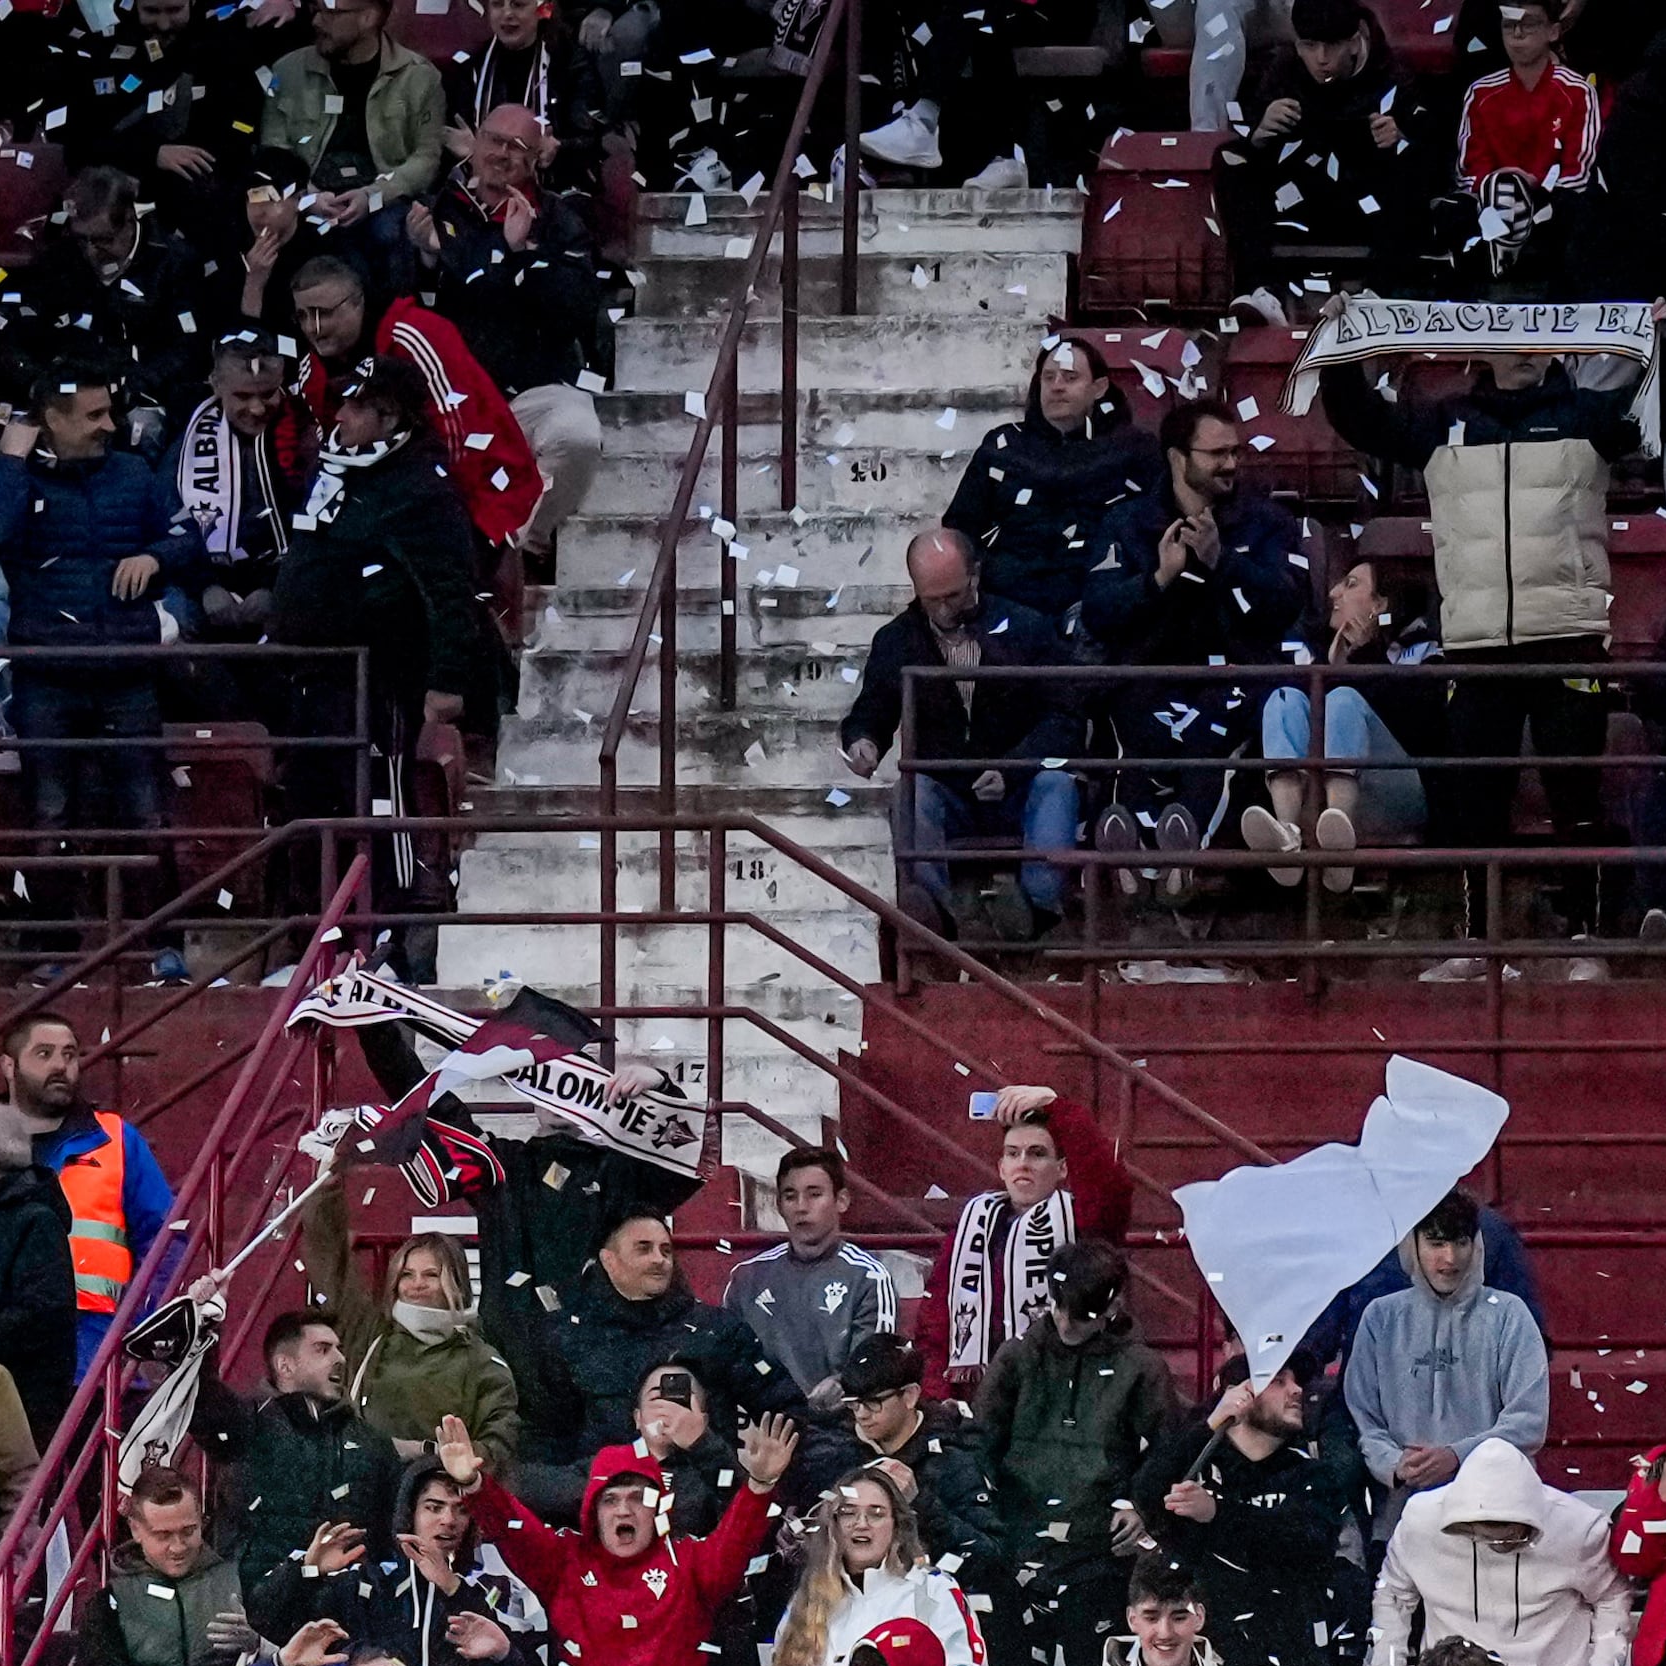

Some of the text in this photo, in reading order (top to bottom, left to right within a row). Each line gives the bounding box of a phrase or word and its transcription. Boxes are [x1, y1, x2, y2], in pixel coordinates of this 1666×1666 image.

[1336, 303, 1580, 344] ALBACETE
[735, 859, 764, 881] 18
[675, 1061, 706, 1083] 17
